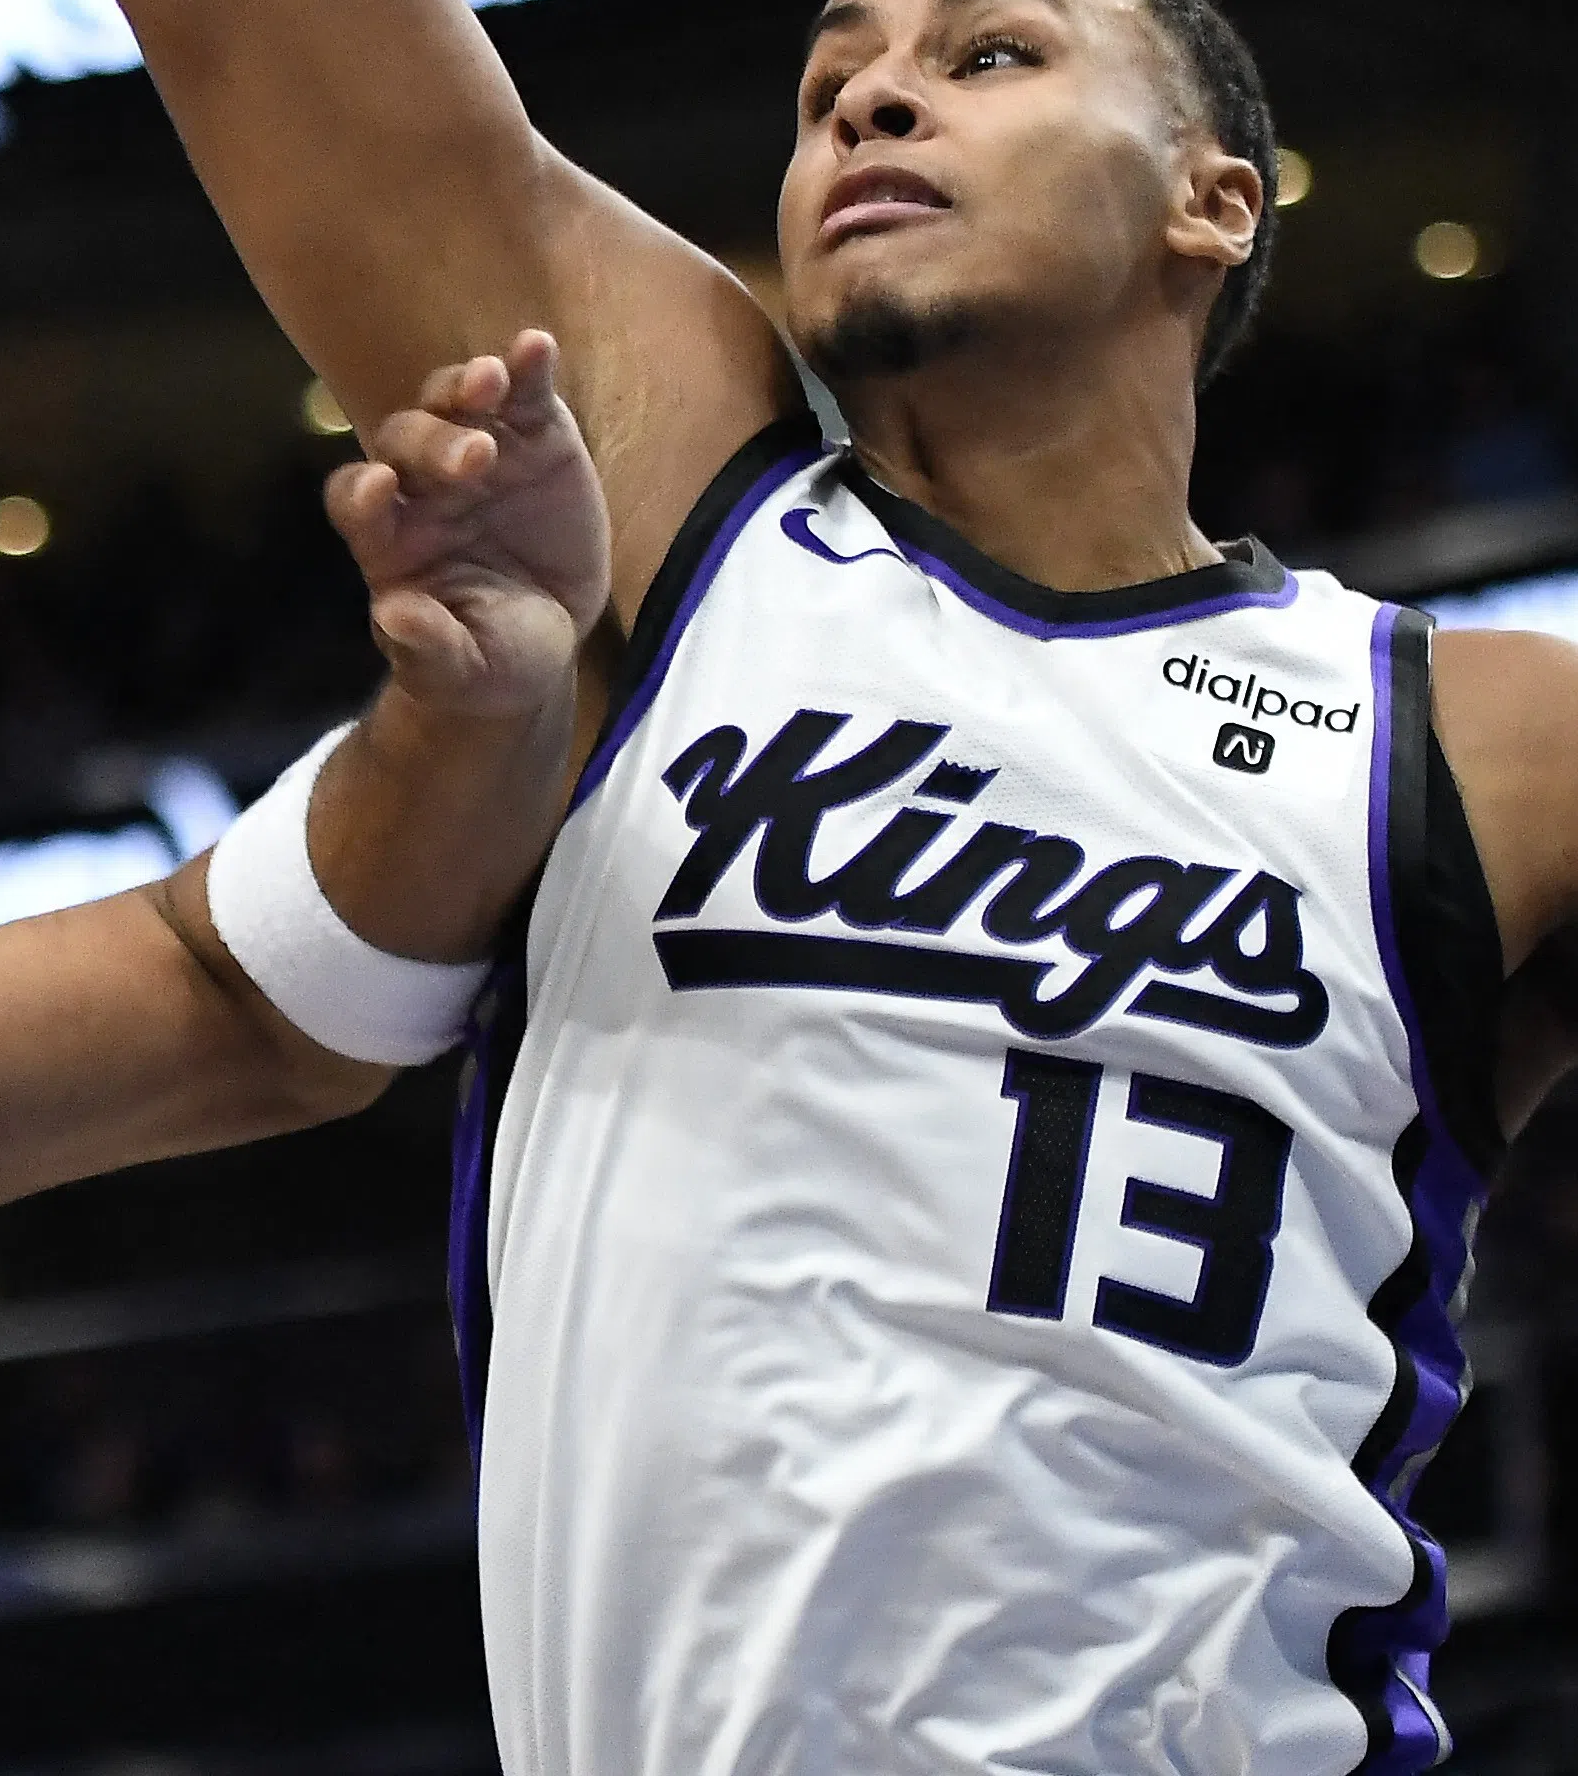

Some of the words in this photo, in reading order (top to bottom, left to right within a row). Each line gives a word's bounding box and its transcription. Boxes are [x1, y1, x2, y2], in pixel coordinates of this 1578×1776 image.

[1162, 654, 1361, 734] dialpad
[652, 707, 1331, 1049] Kings
[985, 1046, 1297, 1369] 13
